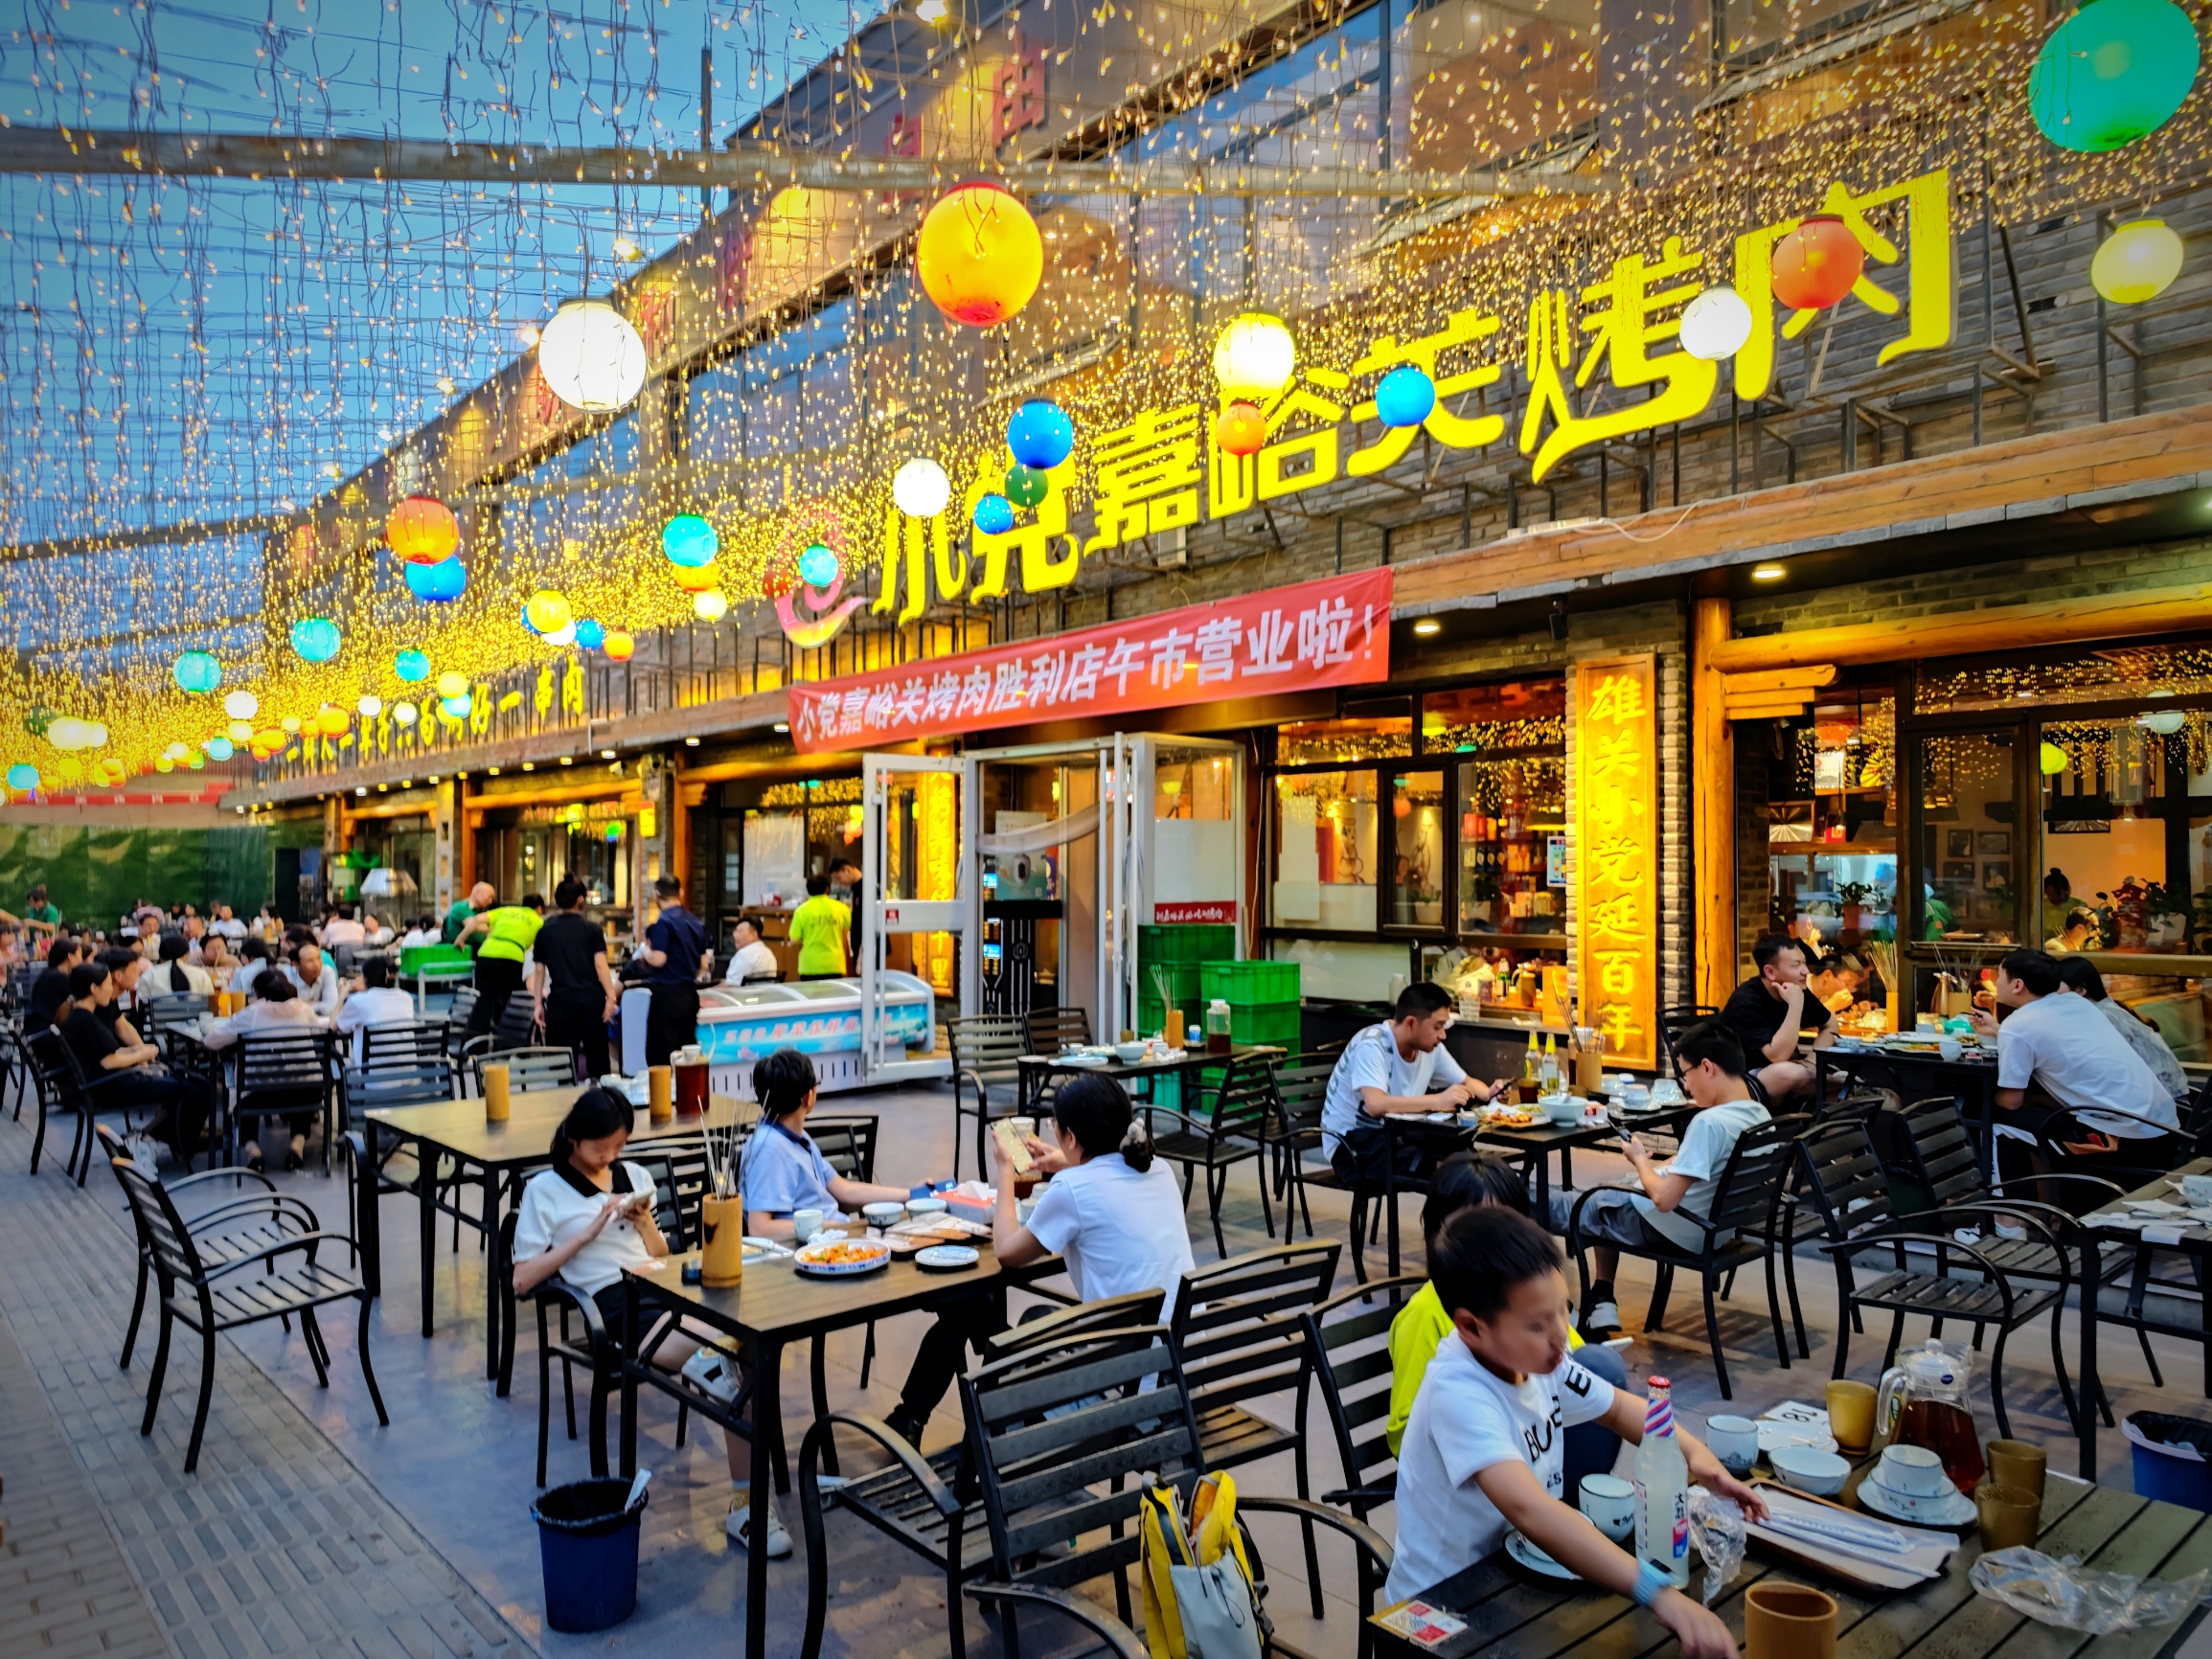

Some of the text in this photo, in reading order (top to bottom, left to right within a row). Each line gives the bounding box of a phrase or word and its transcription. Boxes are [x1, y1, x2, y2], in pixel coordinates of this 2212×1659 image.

[1585, 673, 1647, 1053] 雄关小党延百年
